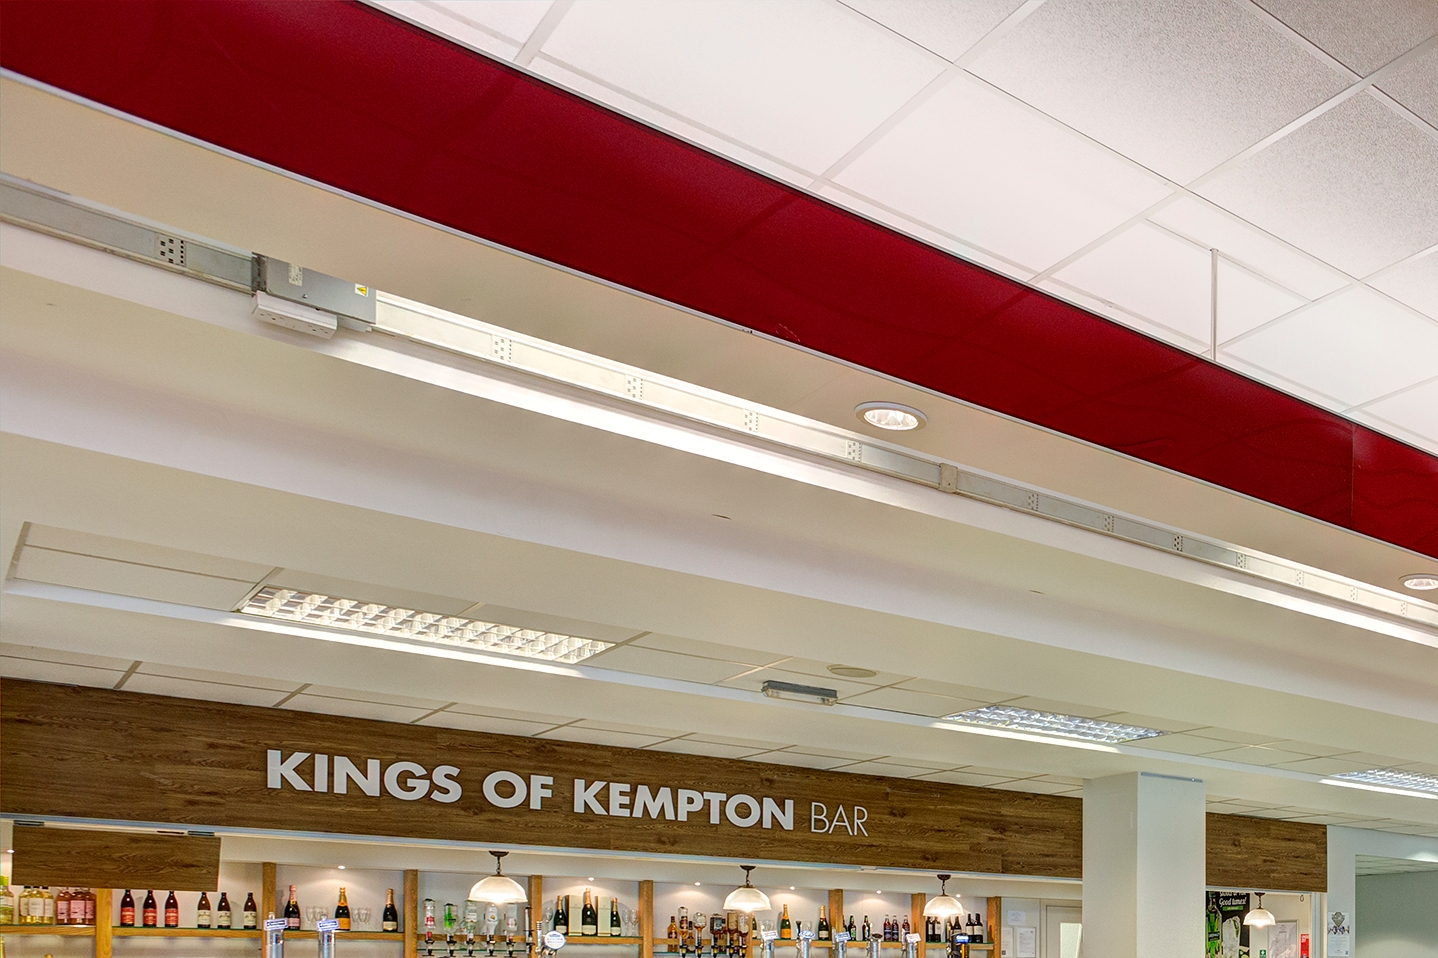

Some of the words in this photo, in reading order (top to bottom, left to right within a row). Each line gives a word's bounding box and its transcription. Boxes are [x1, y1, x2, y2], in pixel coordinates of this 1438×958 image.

[266, 748, 462, 804] KINGS
[482, 769, 554, 811] OF
[573, 777, 795, 831] KEMPTON
[811, 801, 869, 838] BAR
